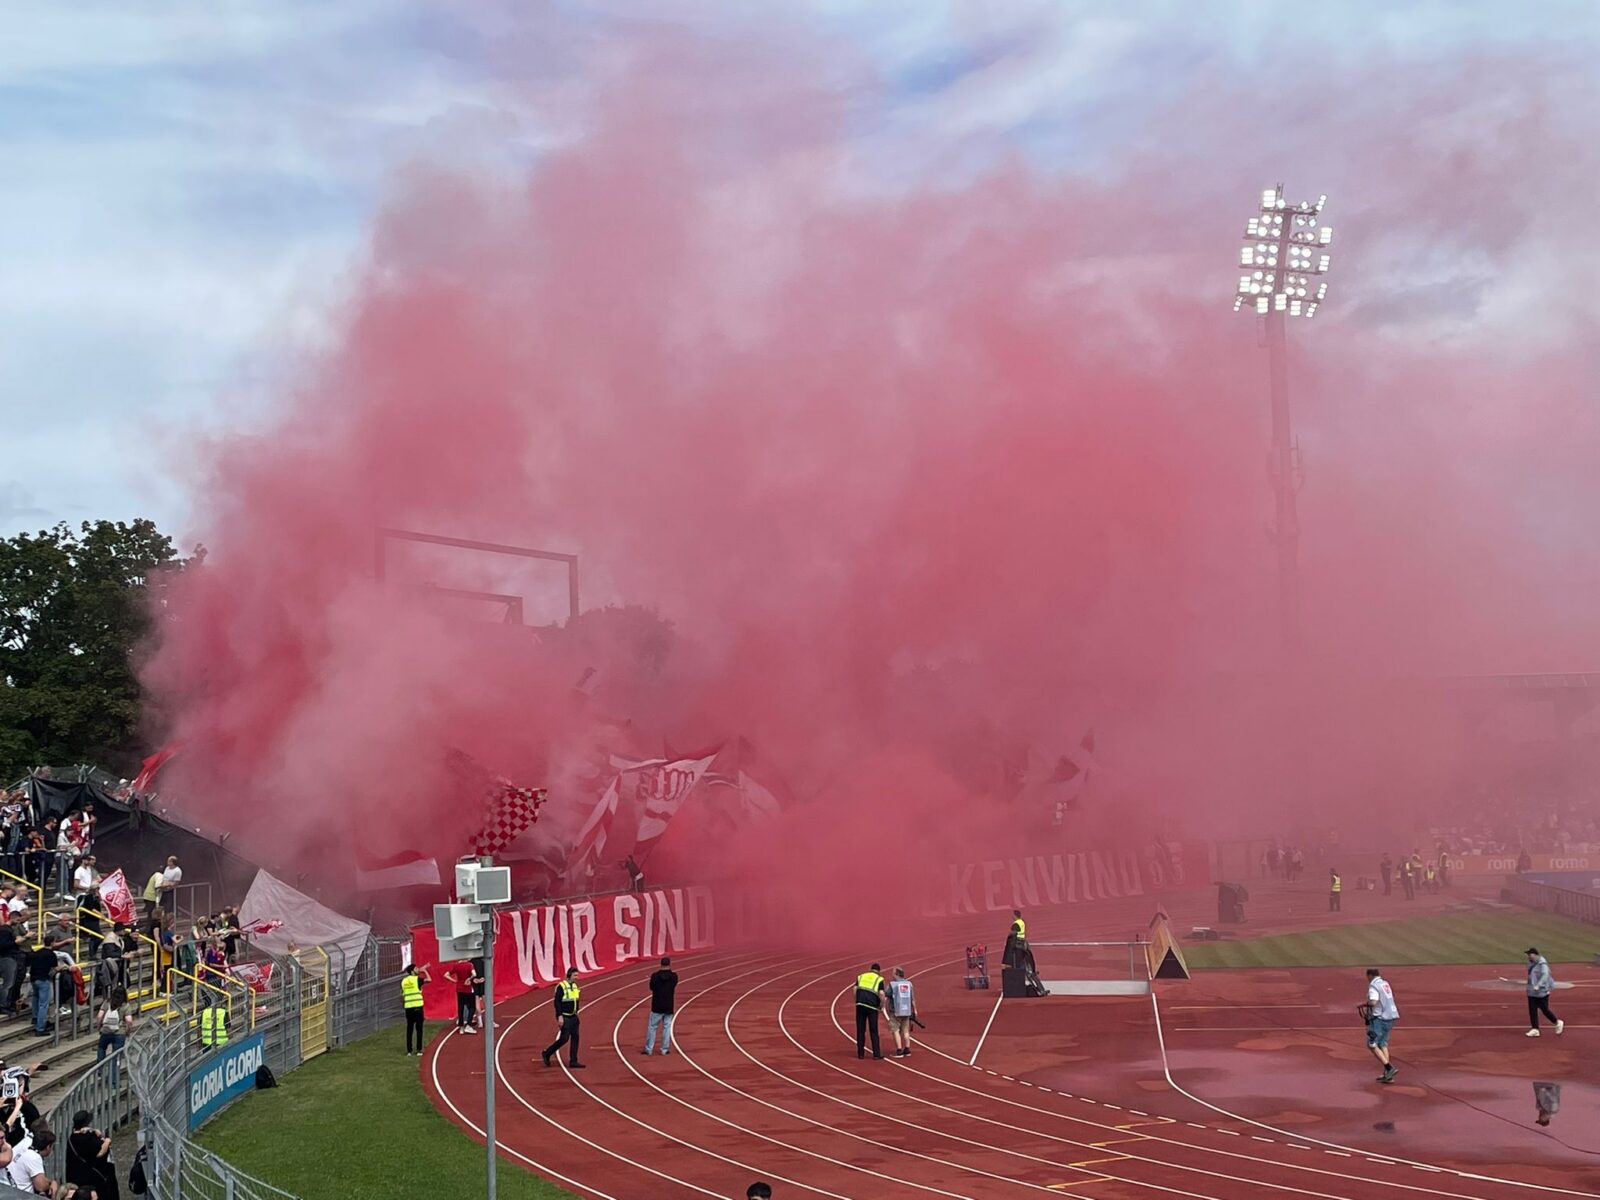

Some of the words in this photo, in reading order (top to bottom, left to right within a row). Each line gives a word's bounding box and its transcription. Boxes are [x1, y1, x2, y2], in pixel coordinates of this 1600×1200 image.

[1487, 857, 1517, 871] rom
[508, 901, 605, 986] WIR
[613, 885, 716, 962] SIND
[191, 1064, 224, 1114] GLORIA
[225, 1044, 263, 1088] GLORIA
